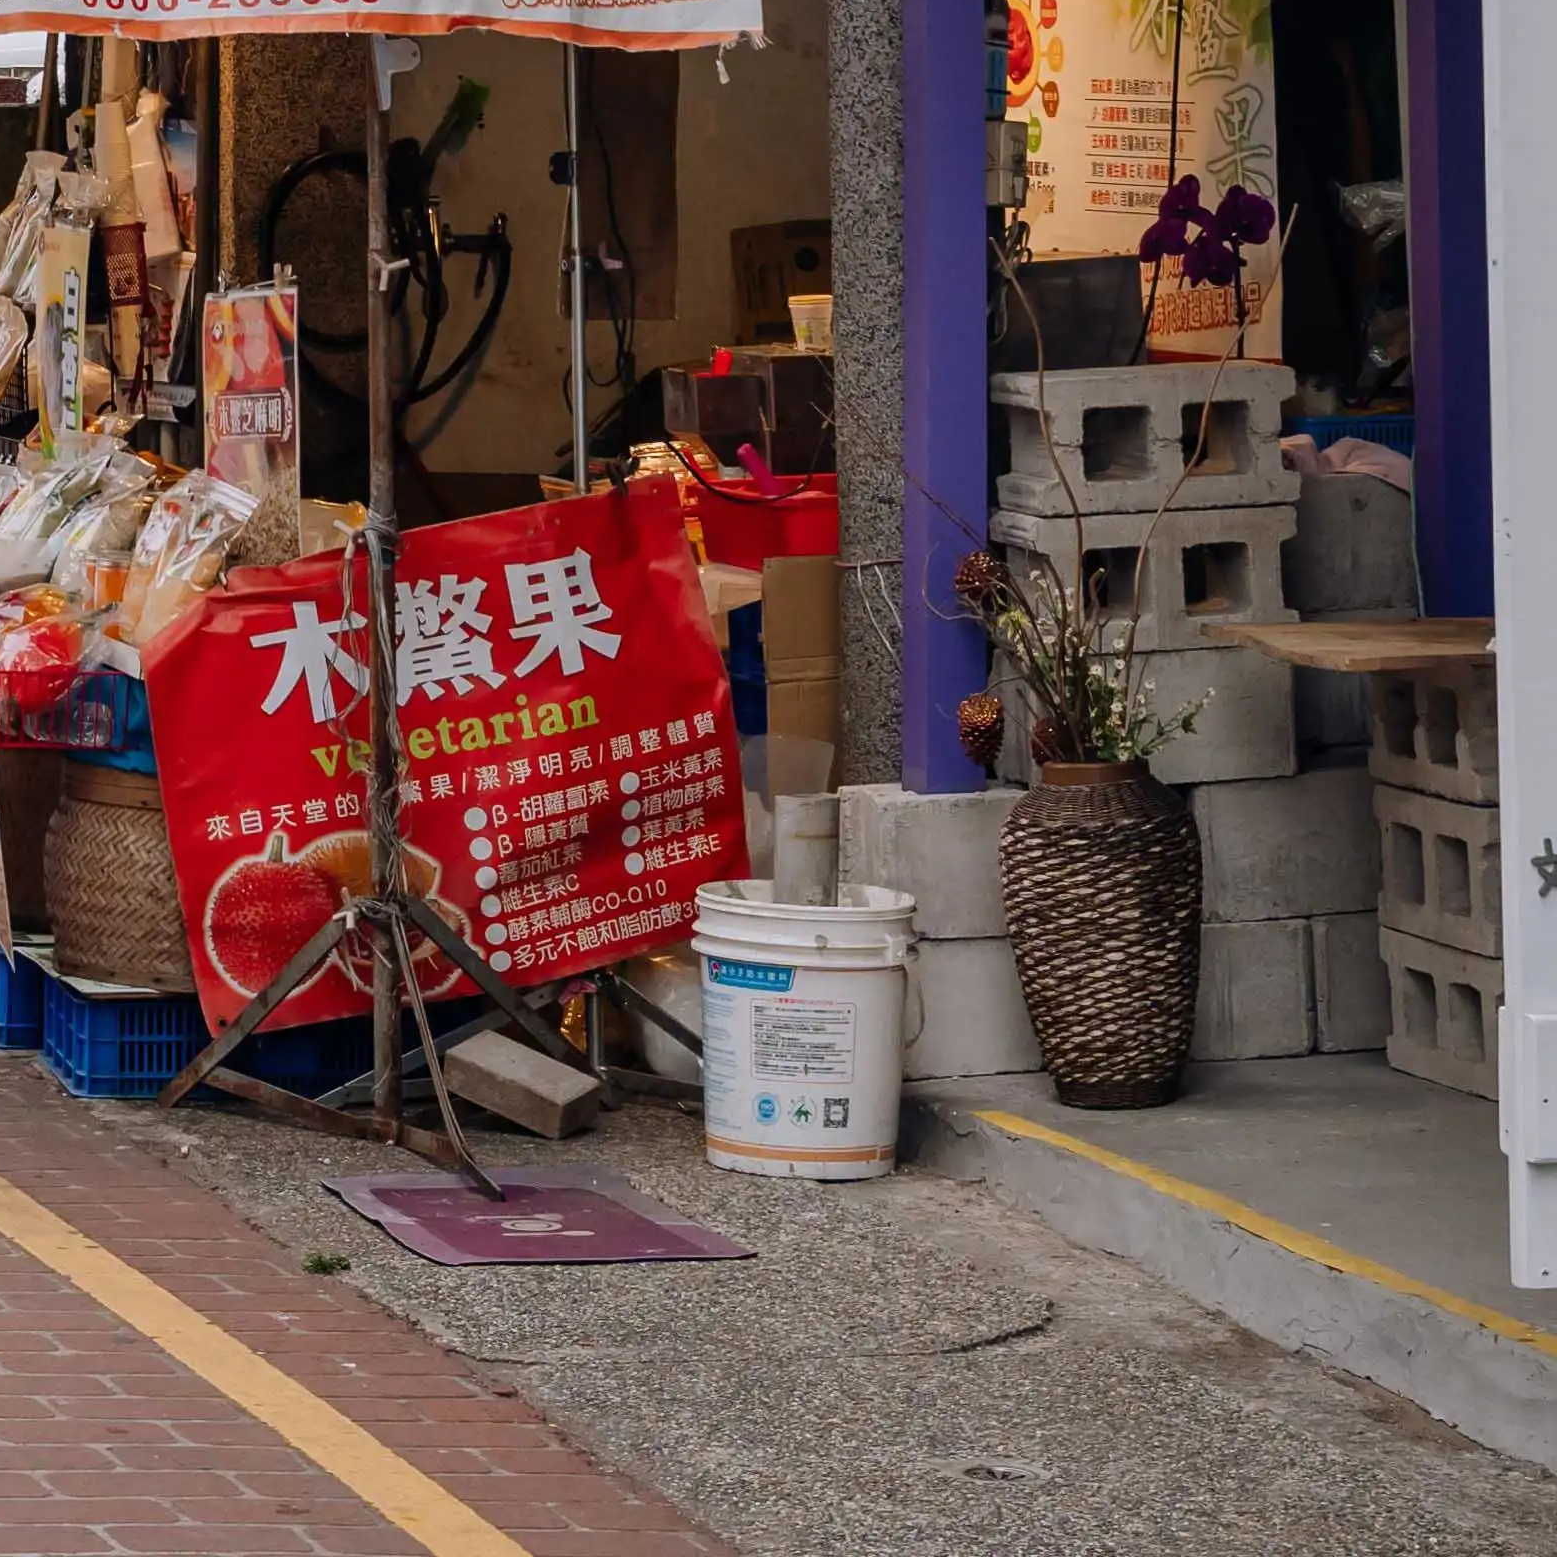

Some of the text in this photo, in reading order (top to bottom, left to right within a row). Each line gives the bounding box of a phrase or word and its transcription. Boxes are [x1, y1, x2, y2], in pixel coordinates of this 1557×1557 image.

[250, 544, 623, 727] 木鱉果
[311, 691, 600, 780] veetarian
[640, 747, 724, 790] 玉米黃素
[641, 776, 726, 819] 植物酵素
[641, 806, 707, 843] 葉黃素
